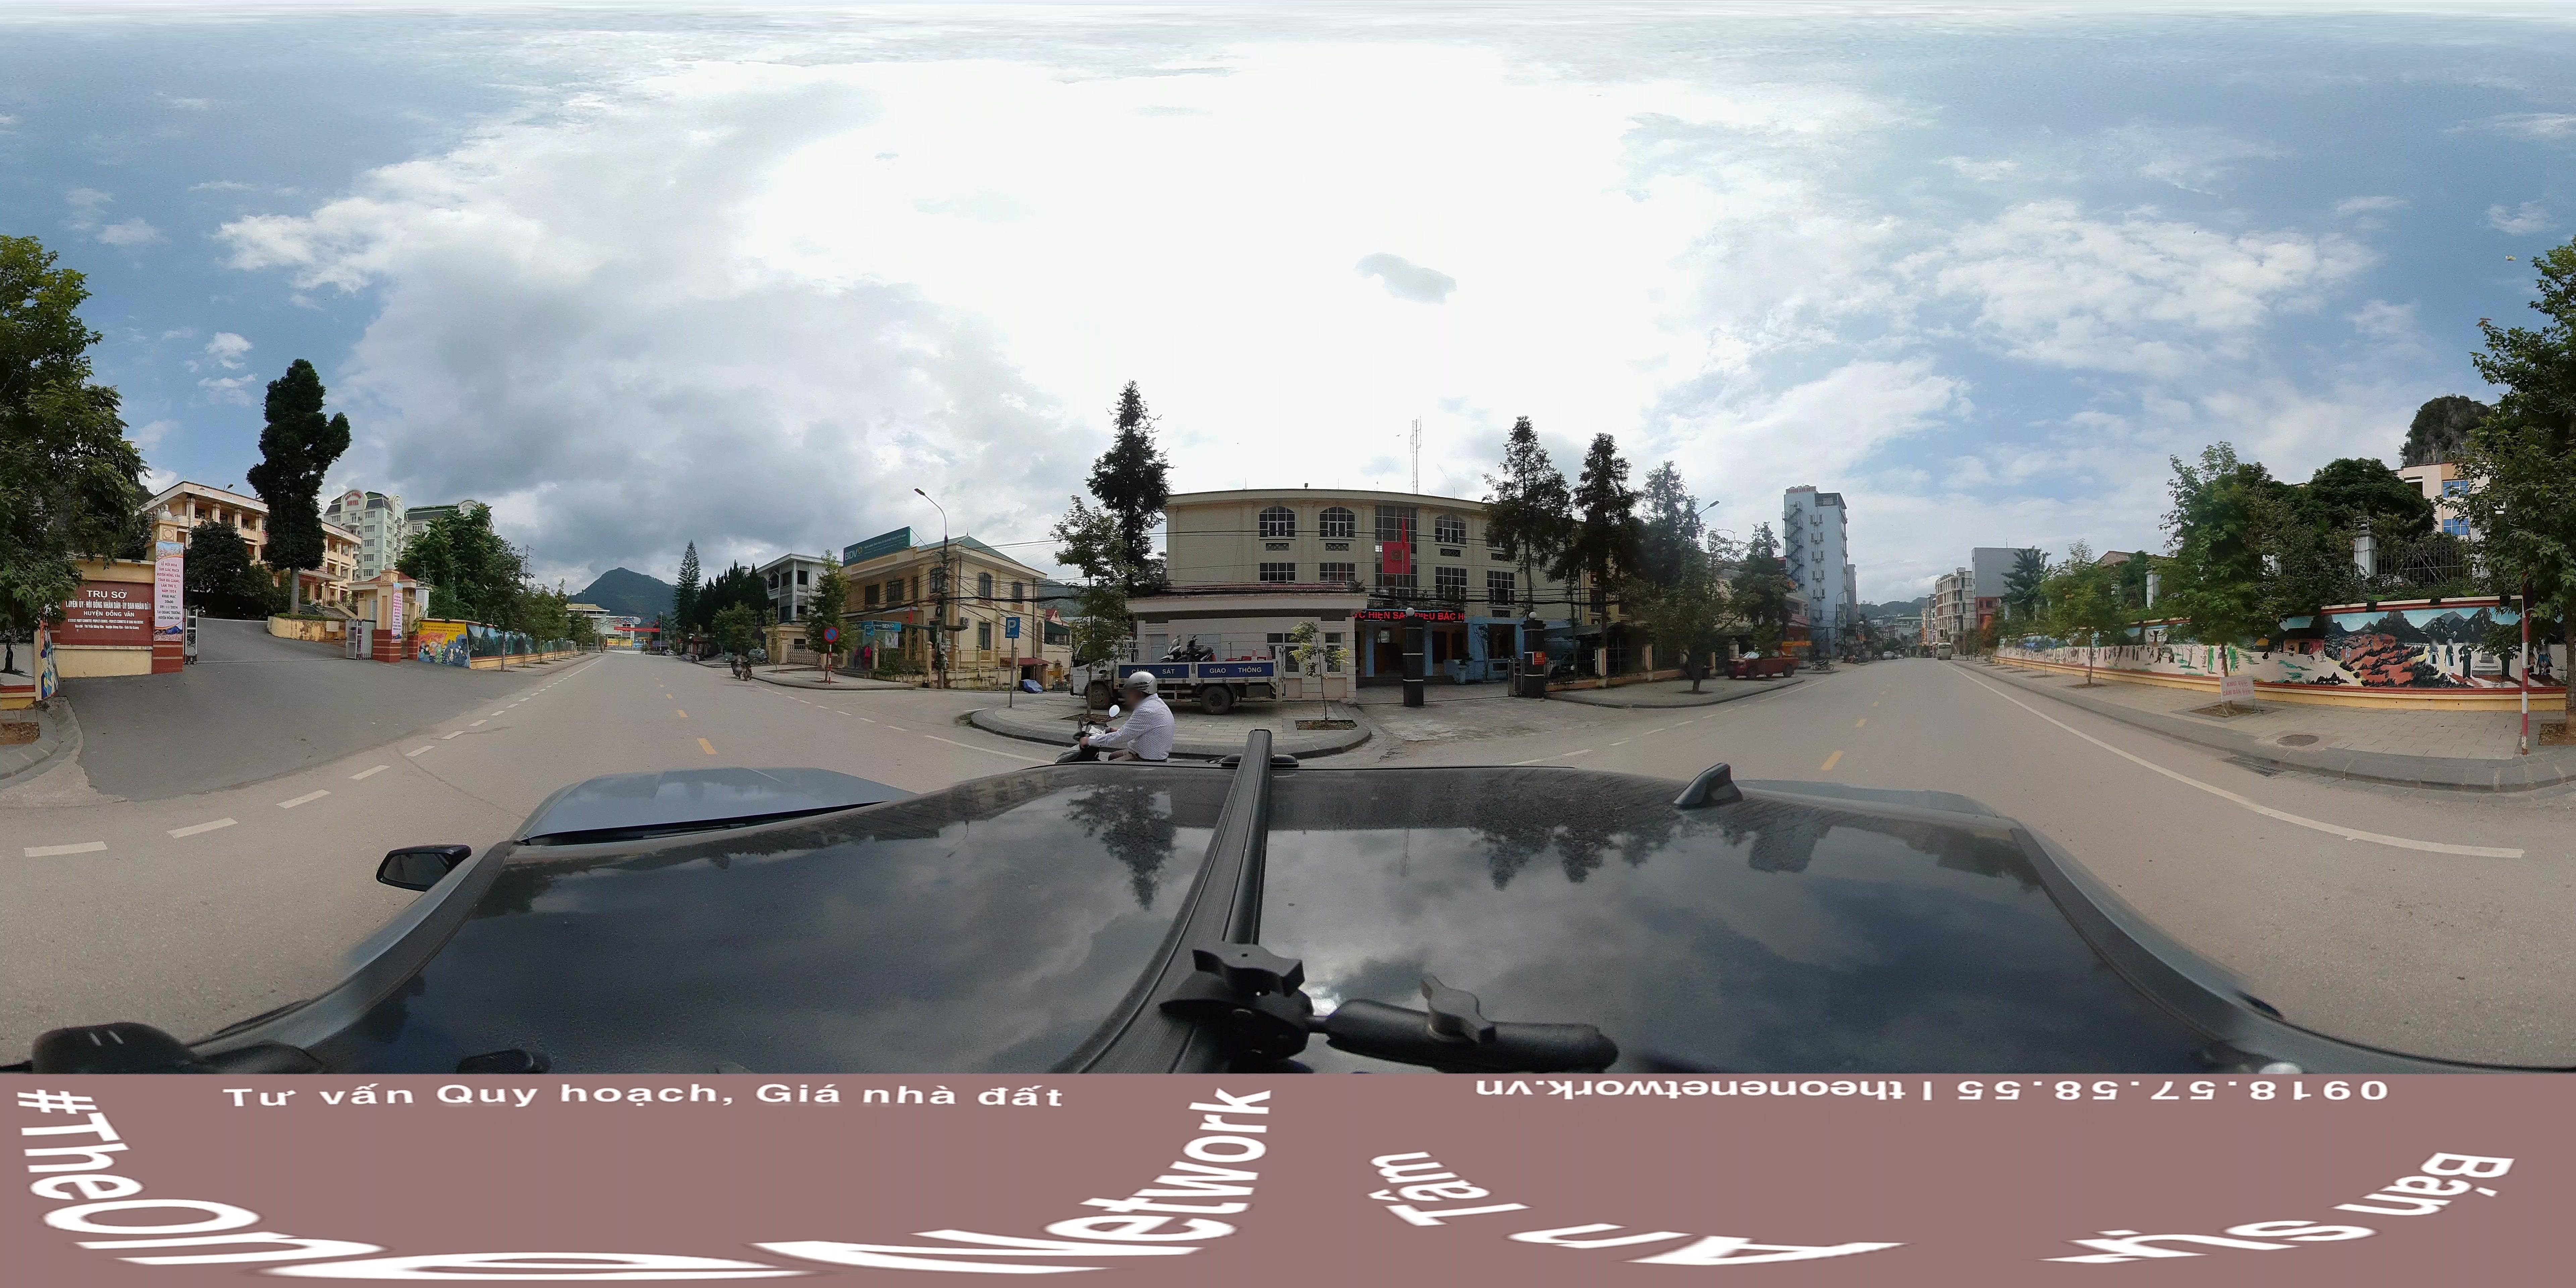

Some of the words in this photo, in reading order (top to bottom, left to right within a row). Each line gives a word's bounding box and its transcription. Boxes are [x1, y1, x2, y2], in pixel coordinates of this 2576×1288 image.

[845, 548, 858, 560] BIDV
[86, 590, 108, 600] TRỤ
[111, 589, 127, 599] SỞ
[79, 598, 84, 608] ỦY
[93, 599, 102, 608] ĐỒNG
[103, 600, 113, 609] NHÂN
[122, 600, 127, 609] ỦY
[135, 601, 144, 610] NHÂN
[1007, 620, 1017, 633] P
